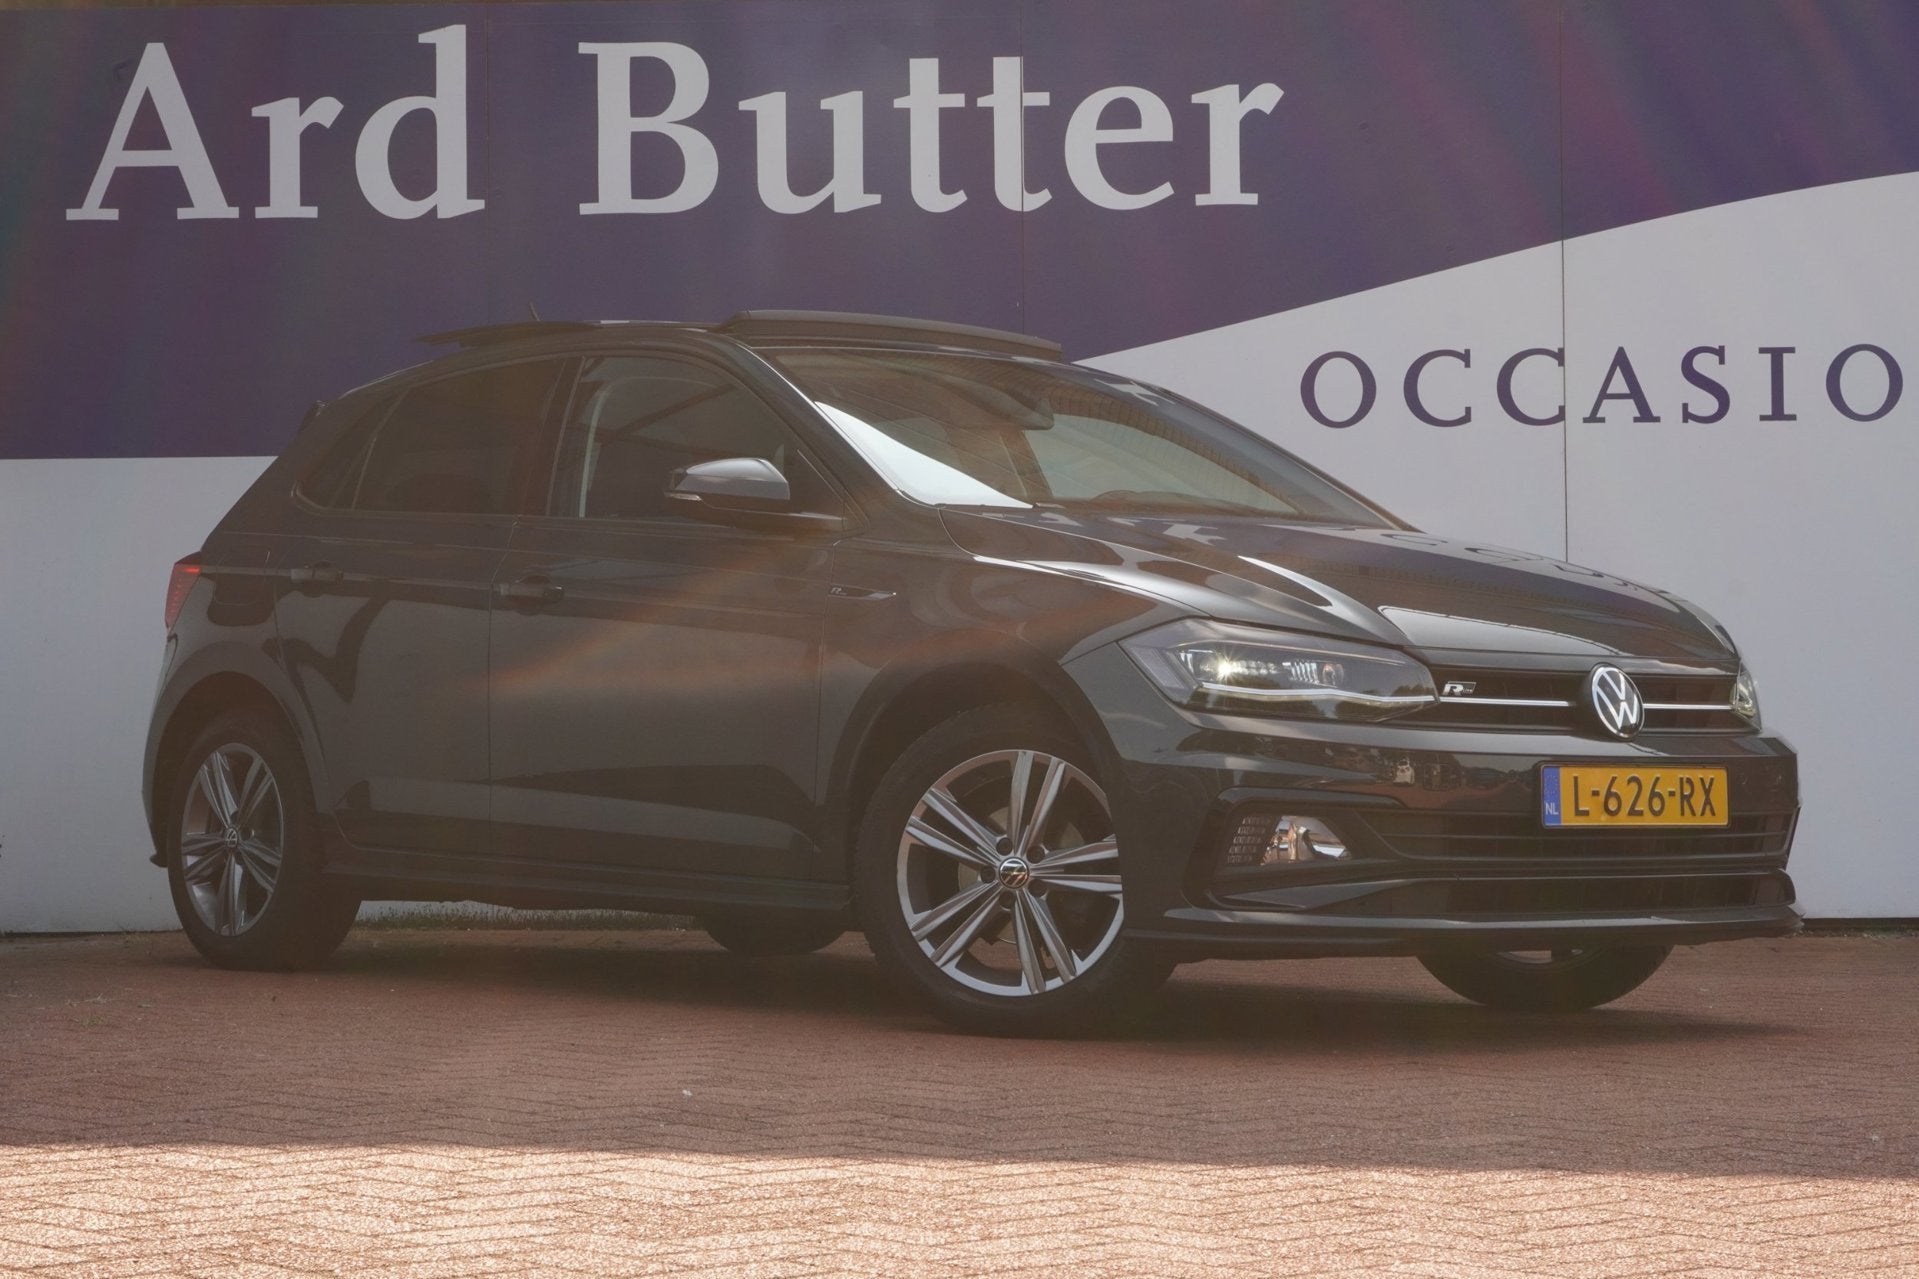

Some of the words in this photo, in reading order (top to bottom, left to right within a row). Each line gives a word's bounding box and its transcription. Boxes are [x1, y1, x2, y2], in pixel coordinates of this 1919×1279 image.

[65, 25, 486, 220] Ard
[579, 42, 1285, 215] Butter
[1301, 344, 1904, 428] OCCASIO
[1545, 802, 1559, 815] NL
[1573, 776, 1716, 817] L-626-RX
